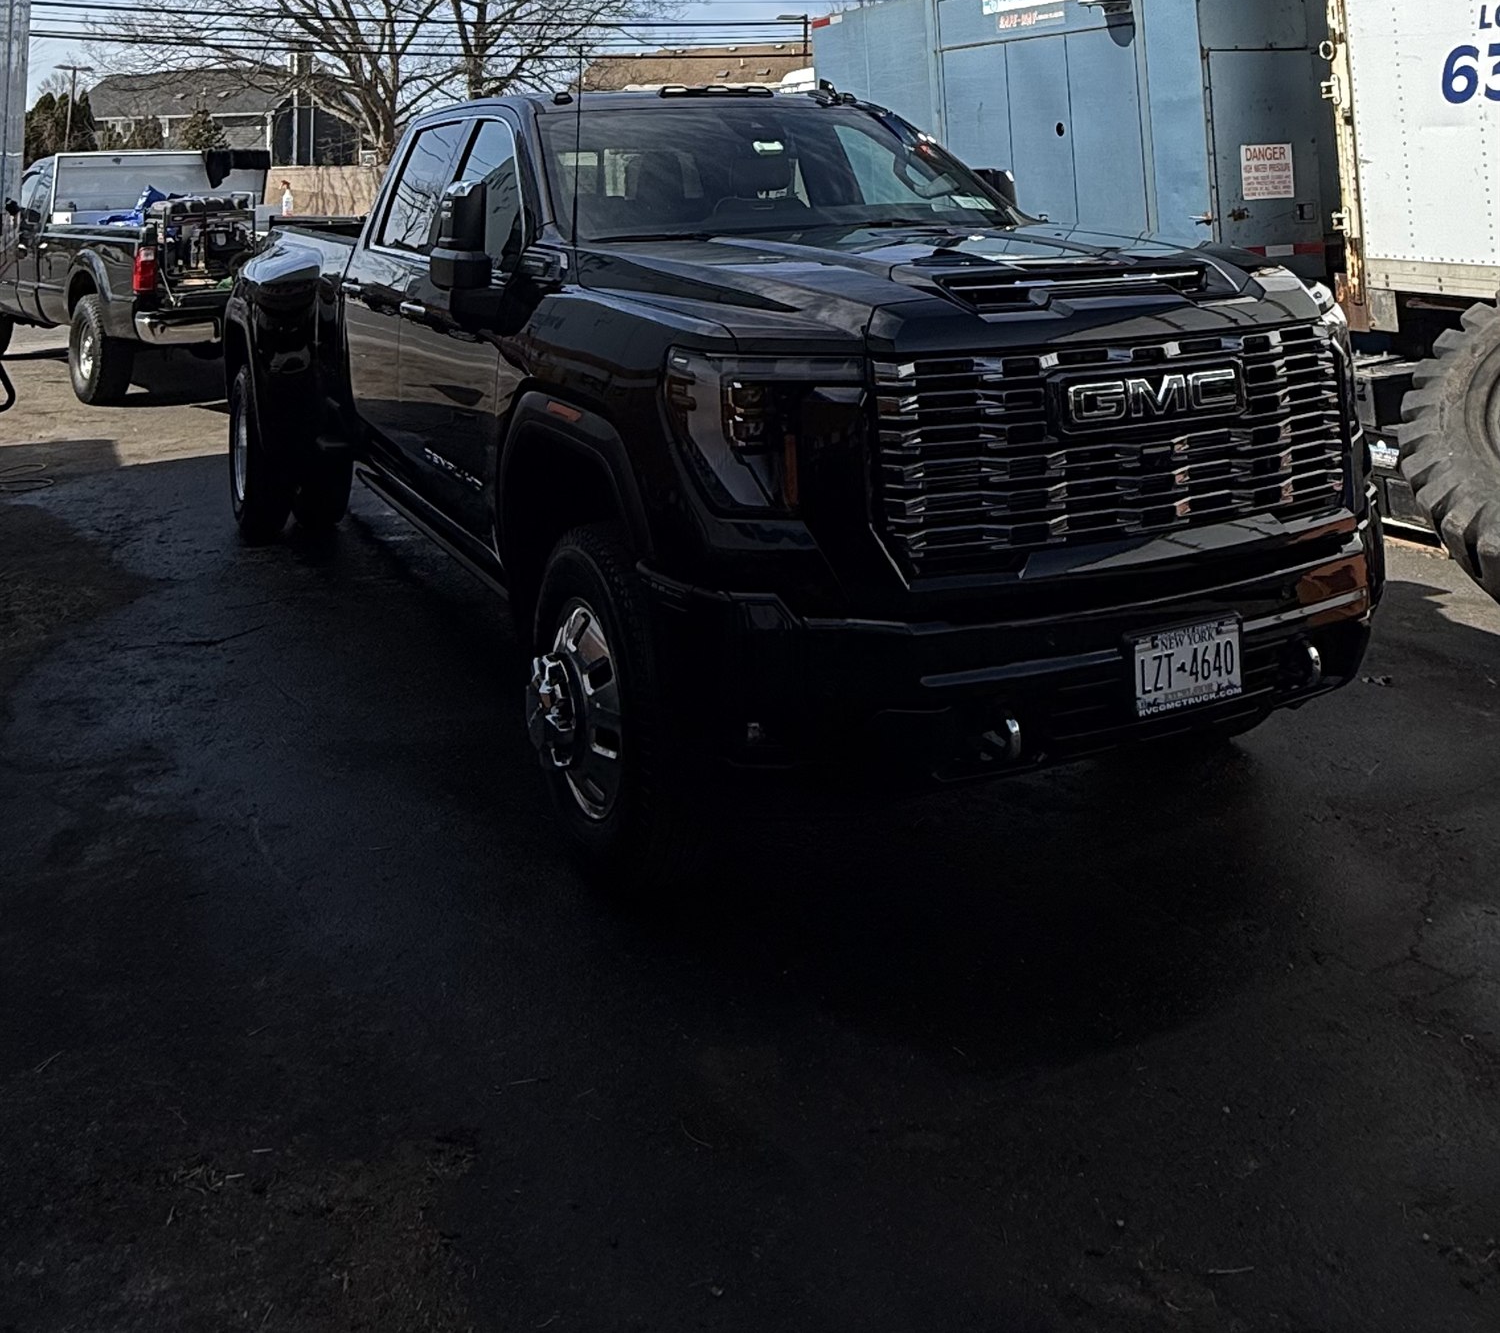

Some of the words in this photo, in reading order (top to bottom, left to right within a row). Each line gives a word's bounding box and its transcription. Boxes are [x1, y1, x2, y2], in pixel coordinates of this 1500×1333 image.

[1245, 146, 1286, 161] DANGER
[1068, 369, 1236, 423] GMC
[1160, 632, 1185, 651] NEW
[1186, 628, 1215, 646] YORK
[1141, 652, 1174, 695] LZT
[1189, 639, 1234, 683] 4640
